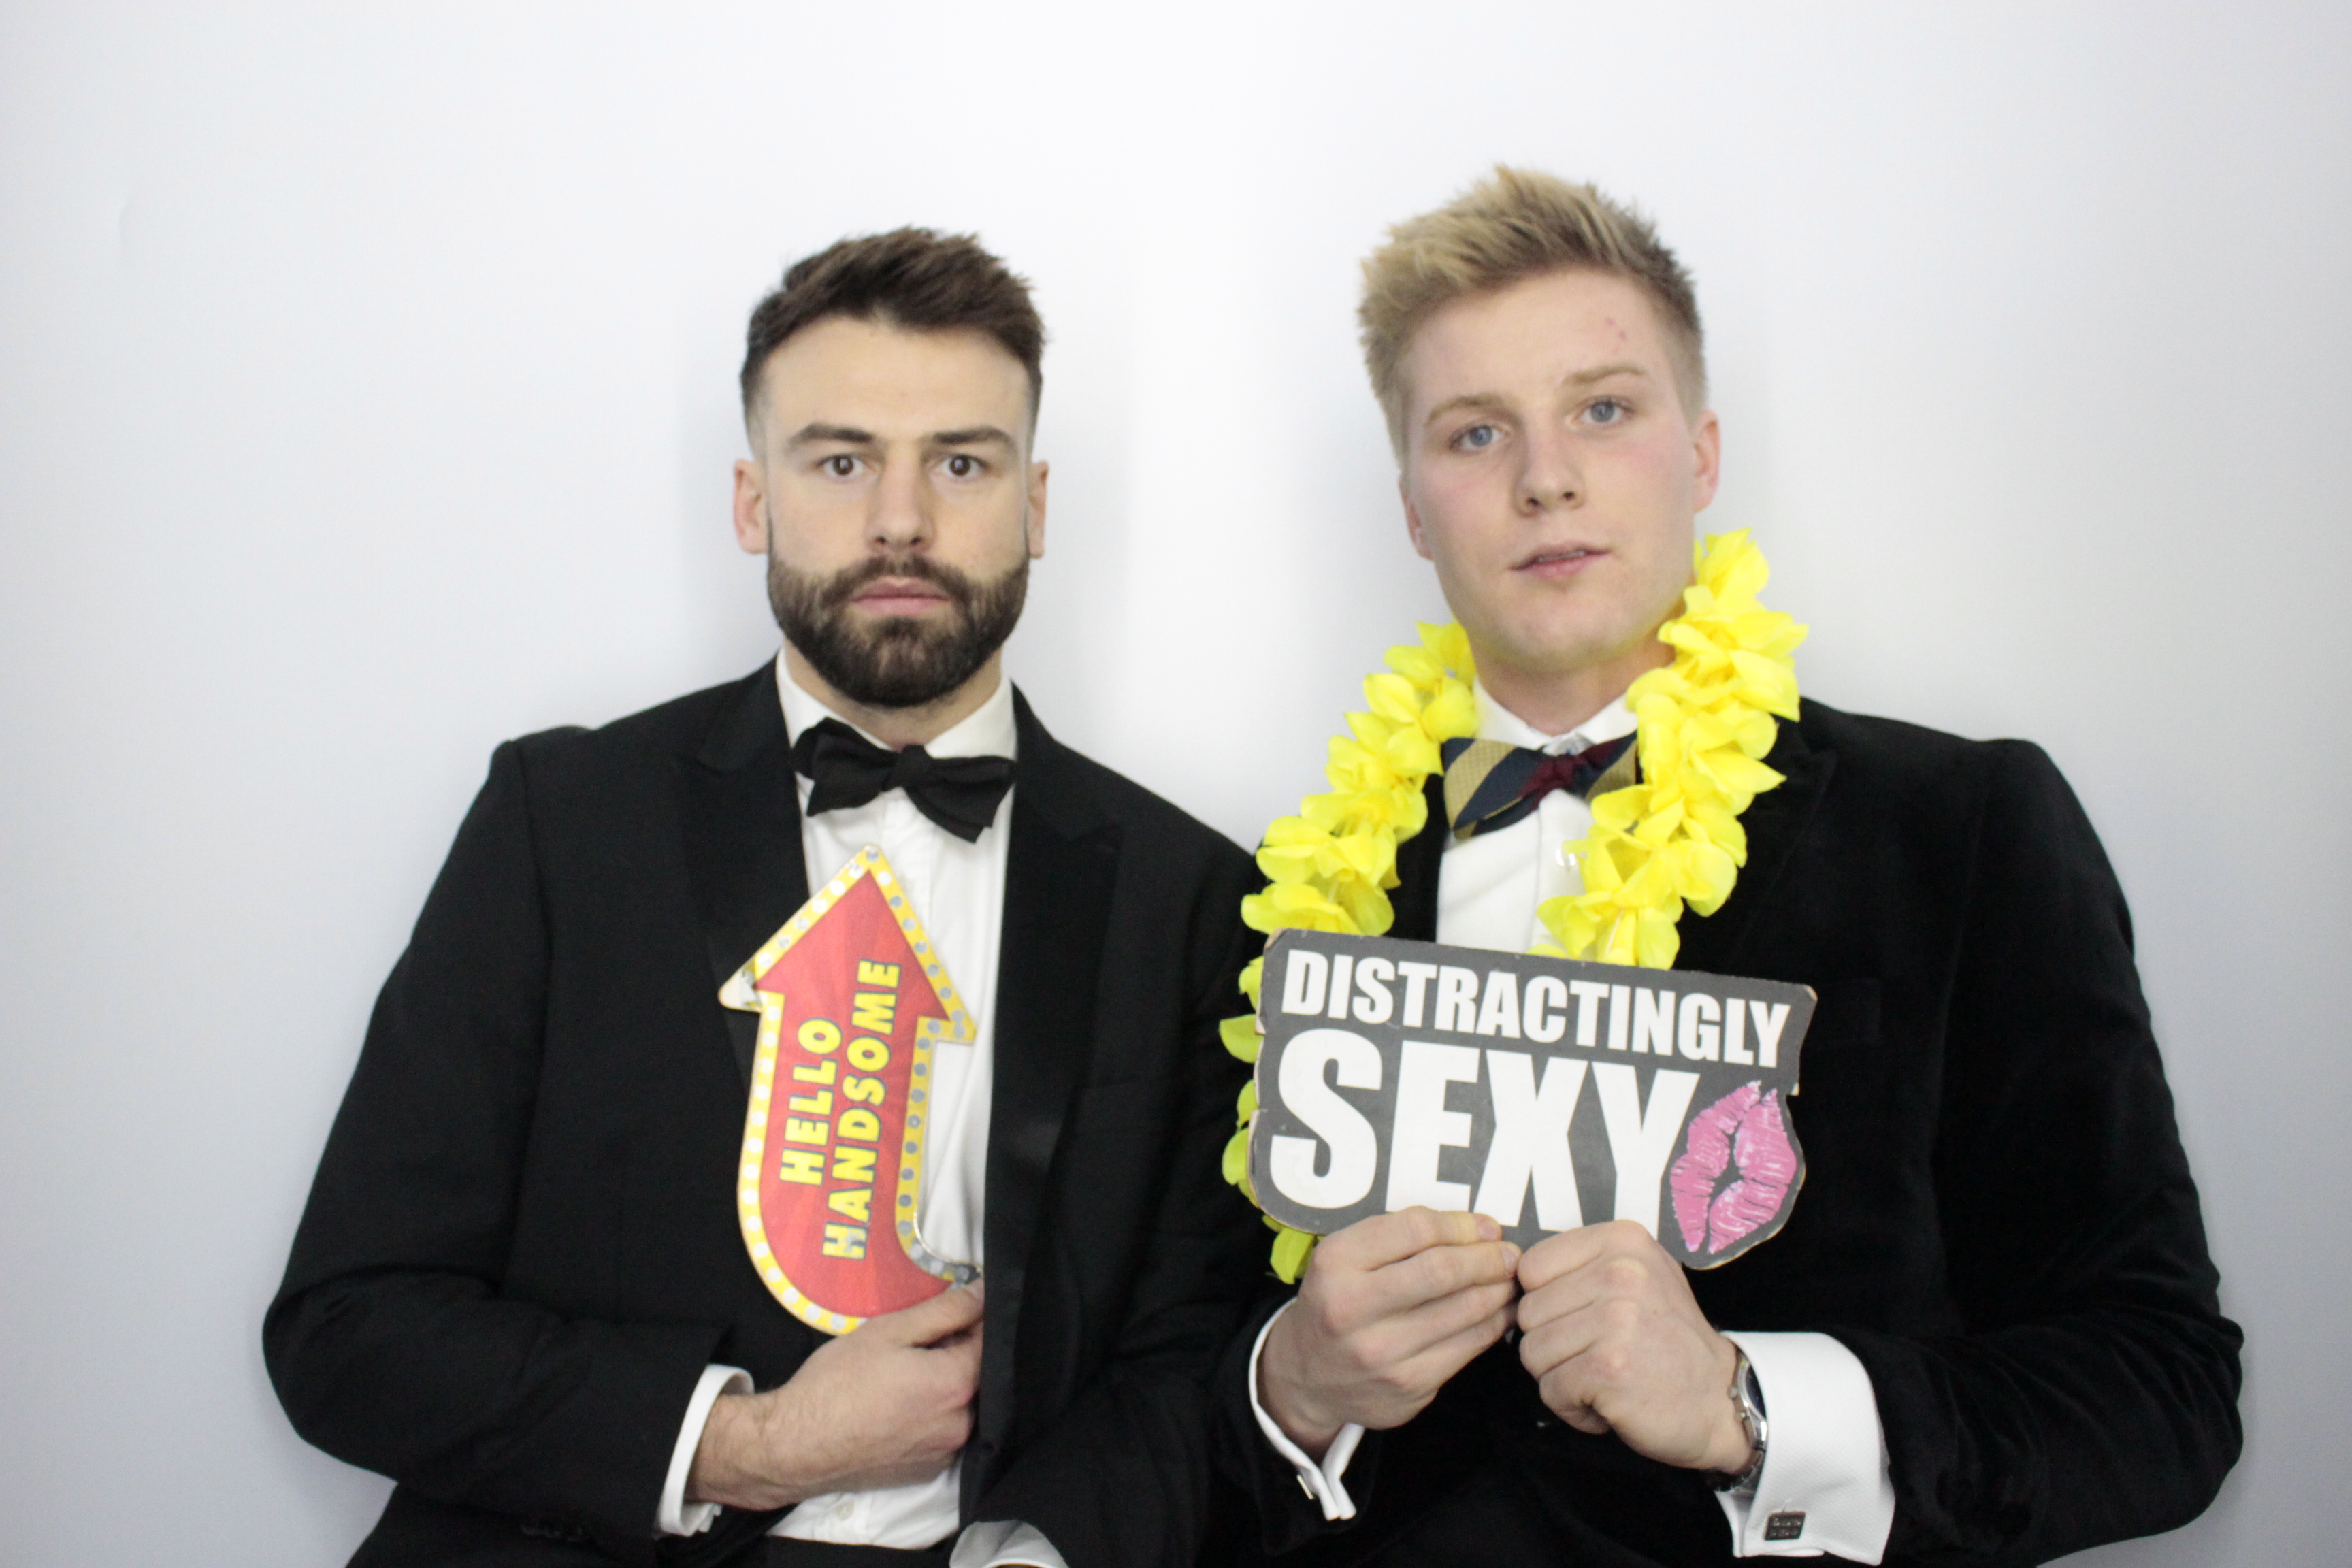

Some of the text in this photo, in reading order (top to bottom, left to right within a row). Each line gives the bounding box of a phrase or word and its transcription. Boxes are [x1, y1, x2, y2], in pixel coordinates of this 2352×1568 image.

[779, 1017, 842, 1186] HELLO
[1281, 949, 1791, 1068] DISTRACTINGLY
[821, 959, 900, 1260] HANDSOME
[1270, 1028, 1700, 1242] SEXY
